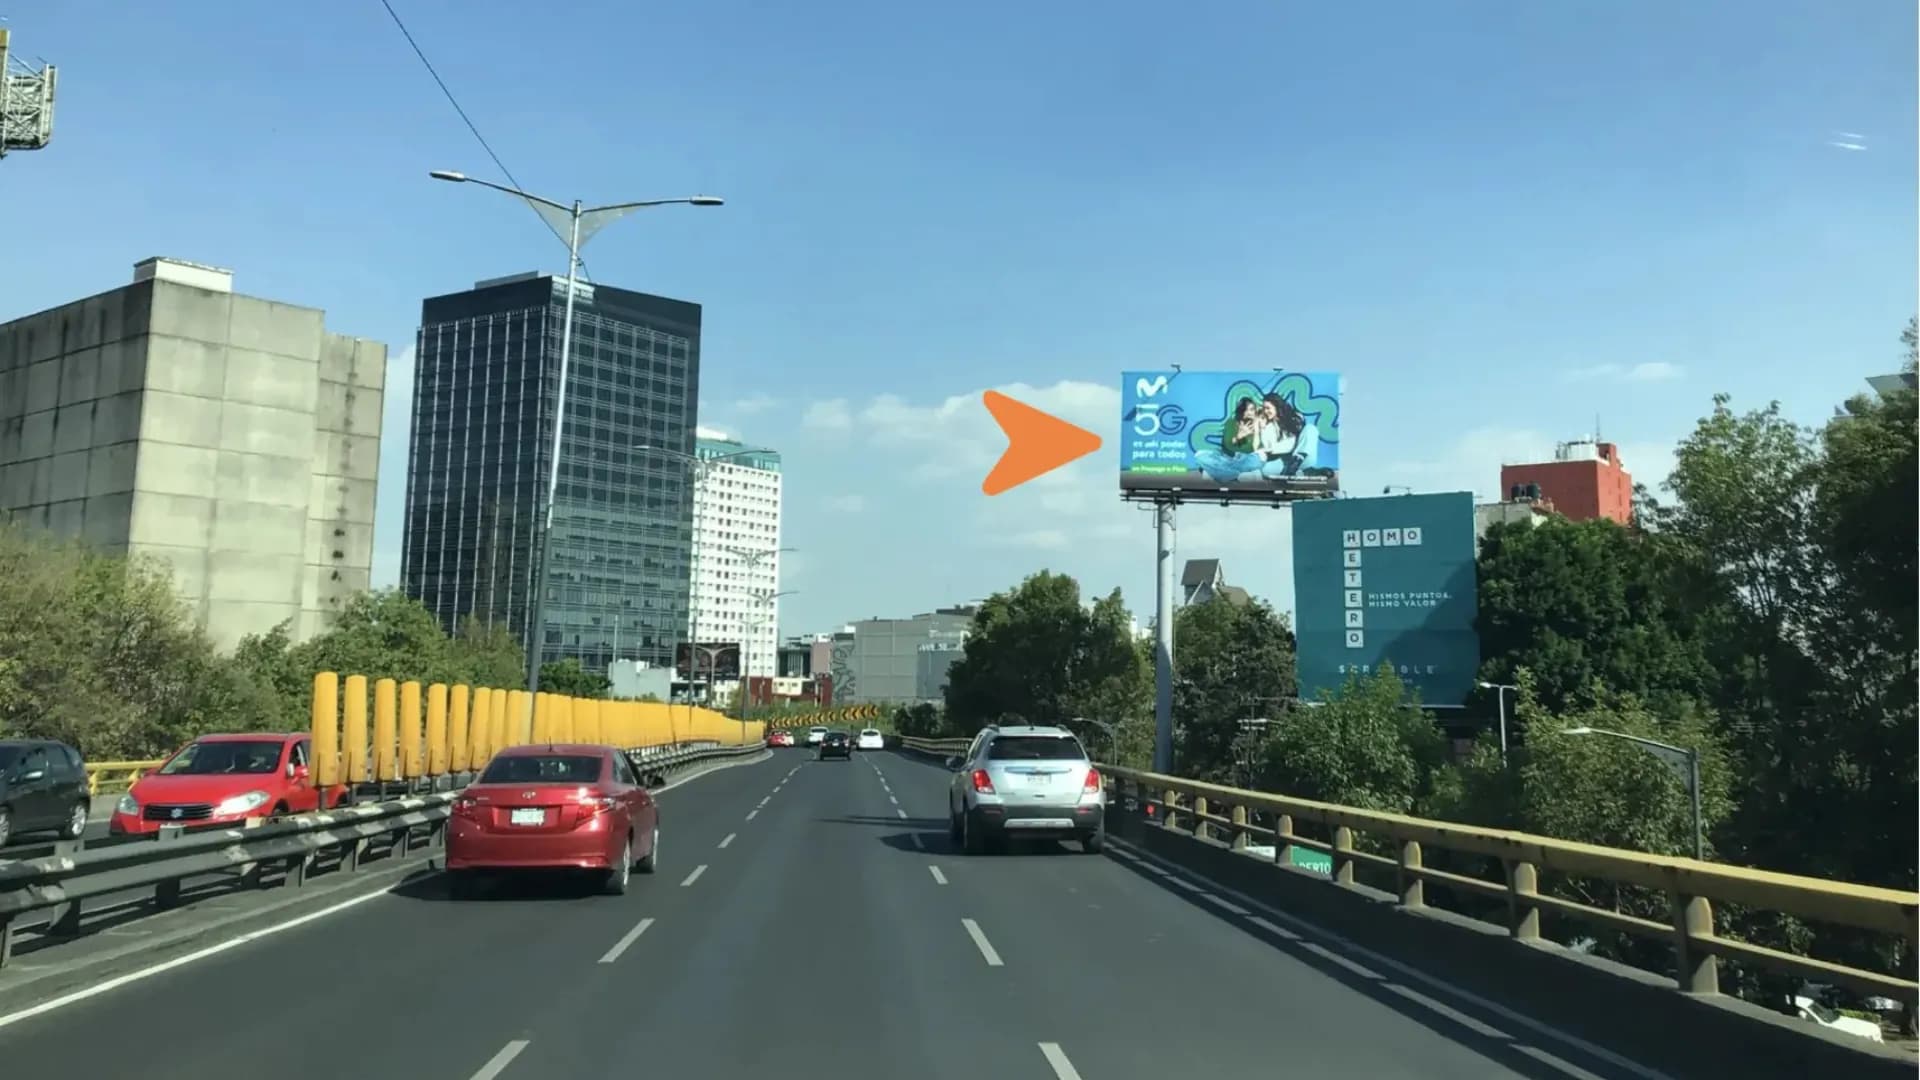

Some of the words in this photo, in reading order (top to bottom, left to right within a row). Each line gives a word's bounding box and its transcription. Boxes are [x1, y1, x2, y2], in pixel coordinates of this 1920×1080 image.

[1134, 403, 1188, 436] 5G
[1160, 440, 1186, 449] poder
[1132, 450, 1155, 460] para
[1157, 449, 1187, 459] todos
[1346, 529, 1418, 544] HOMO
[1368, 592, 1406, 600] MISMOS
[1368, 600, 1400, 608] MISMO
[1338, 664, 1436, 674] SCRBLE
